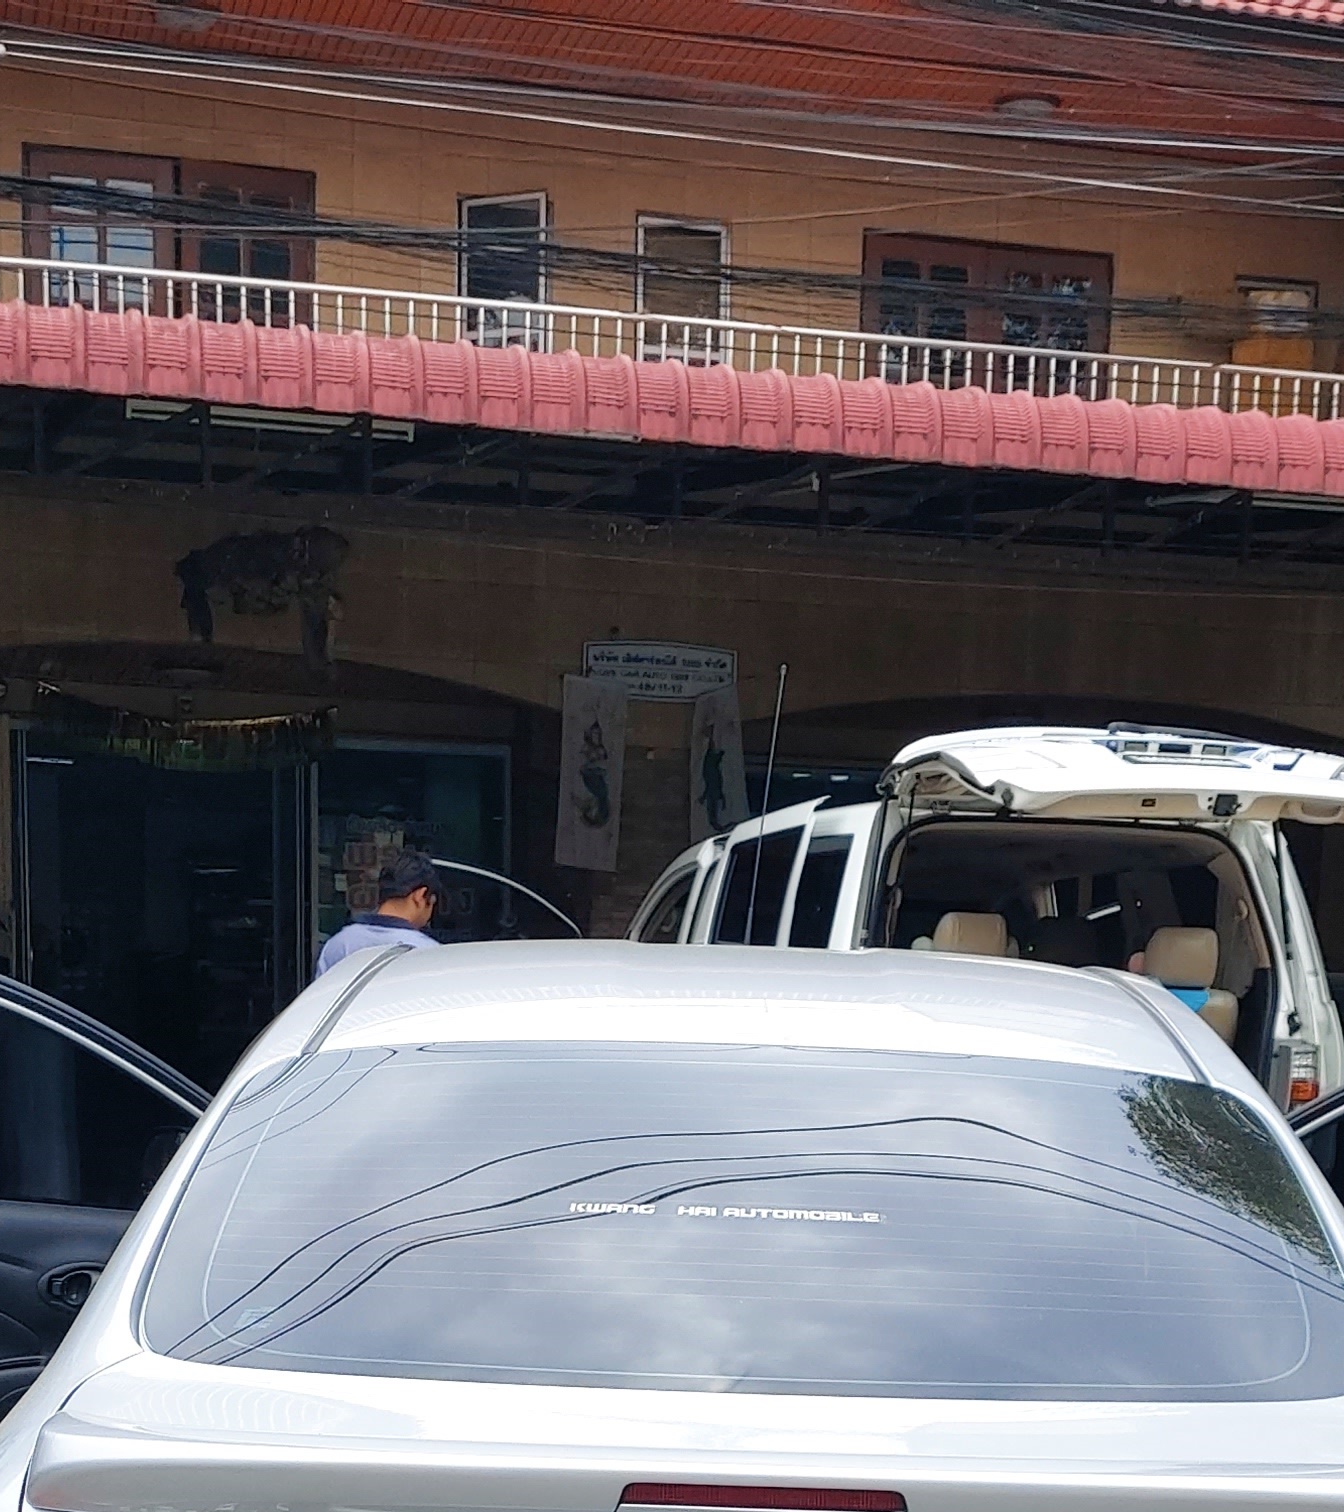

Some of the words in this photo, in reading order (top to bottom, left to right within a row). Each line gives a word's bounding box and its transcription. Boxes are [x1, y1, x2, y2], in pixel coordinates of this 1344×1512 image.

[569, 1201, 657, 1215] KWANG
[677, 1204, 716, 1217] HAI
[722, 1206, 881, 1223] AUTOMOBILE
